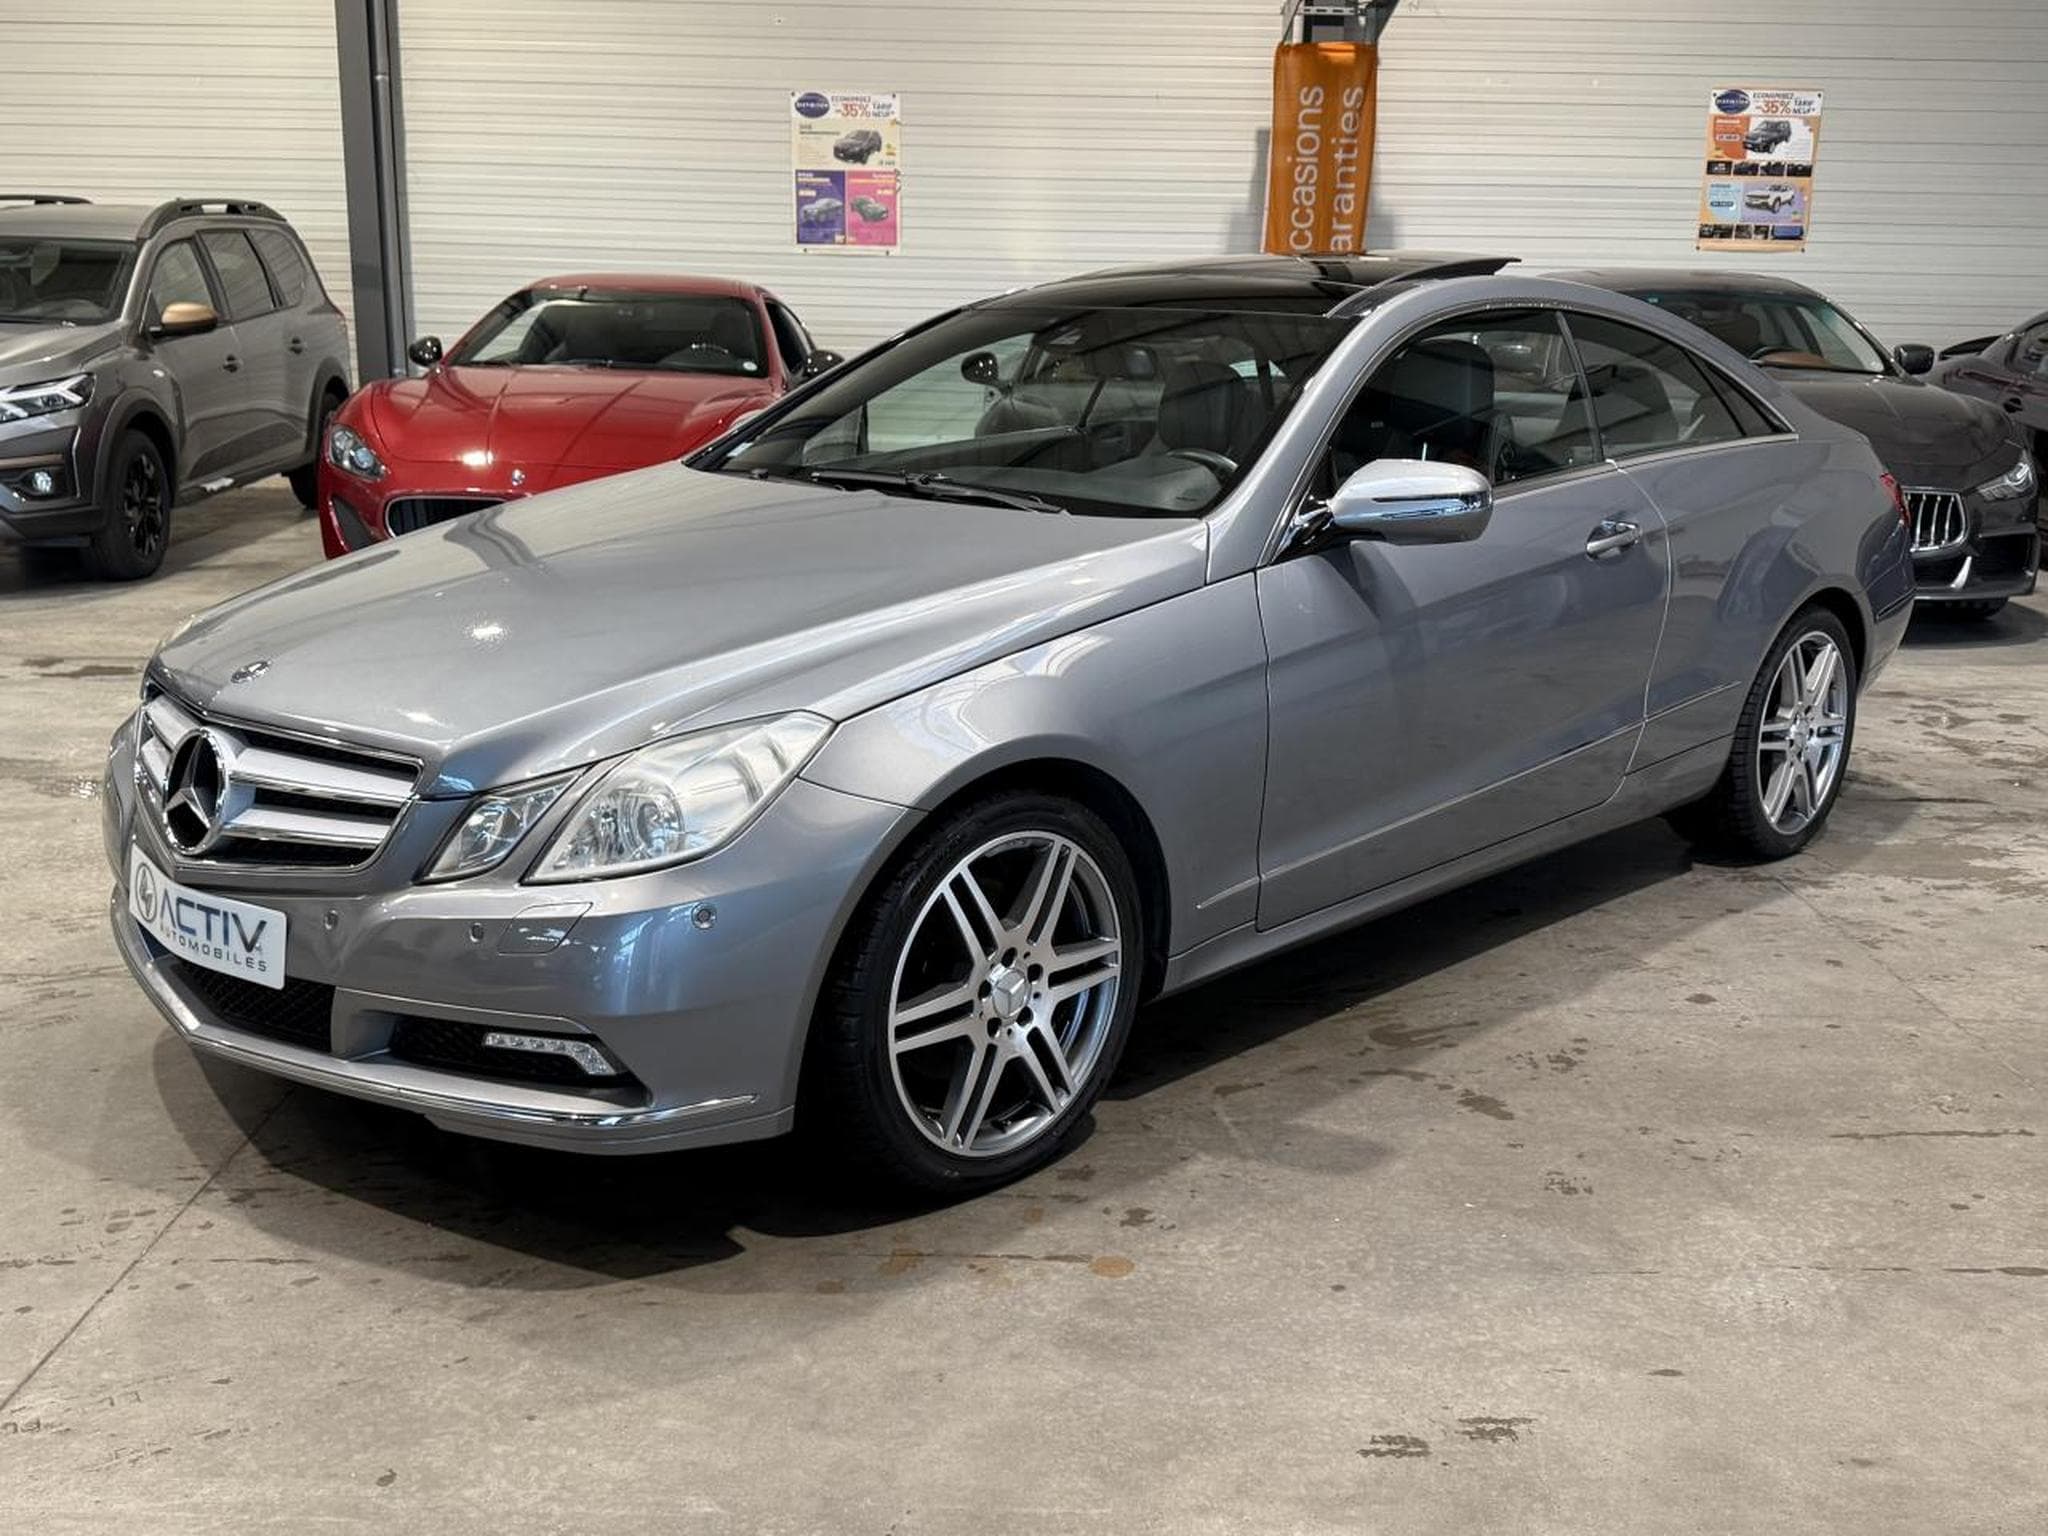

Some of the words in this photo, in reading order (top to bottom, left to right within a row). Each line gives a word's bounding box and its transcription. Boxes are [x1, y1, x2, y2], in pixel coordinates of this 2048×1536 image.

[835, 102, 871, 118] -35%
[1755, 99, 1791, 114] -35%
[1286, 85, 1325, 252] ccasions
[1330, 86, 1365, 252] aranties
[160, 888, 267, 953] ACTIV
[160, 923, 267, 973] AUTOMOBILES
